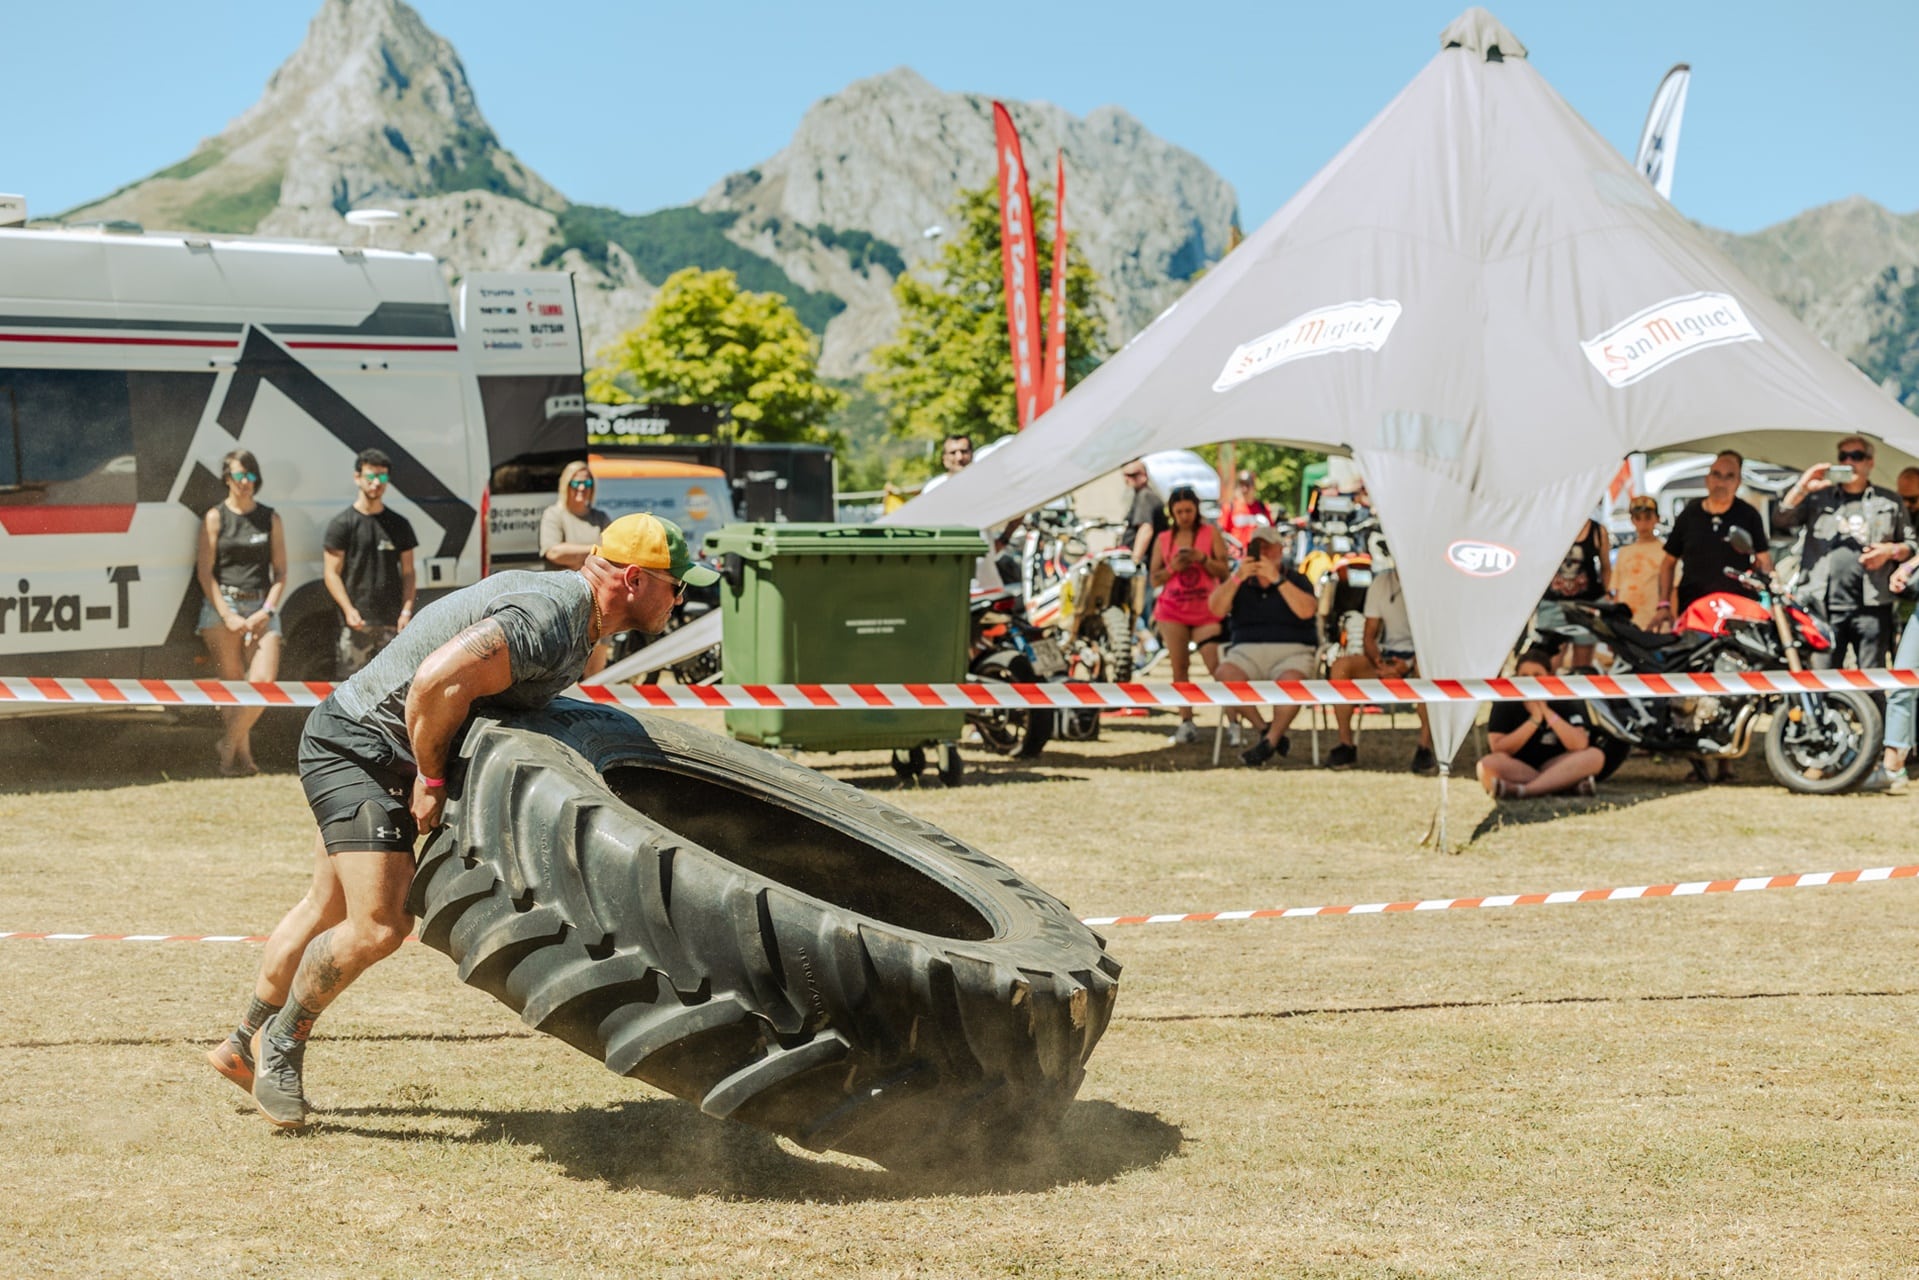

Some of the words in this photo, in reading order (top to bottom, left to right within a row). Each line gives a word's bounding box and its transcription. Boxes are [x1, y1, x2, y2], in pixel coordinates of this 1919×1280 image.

[1642, 306, 1738, 345] Miguel
[613, 418, 668, 435] GUZZI
[780, 765, 1075, 951] GOODYEAR
